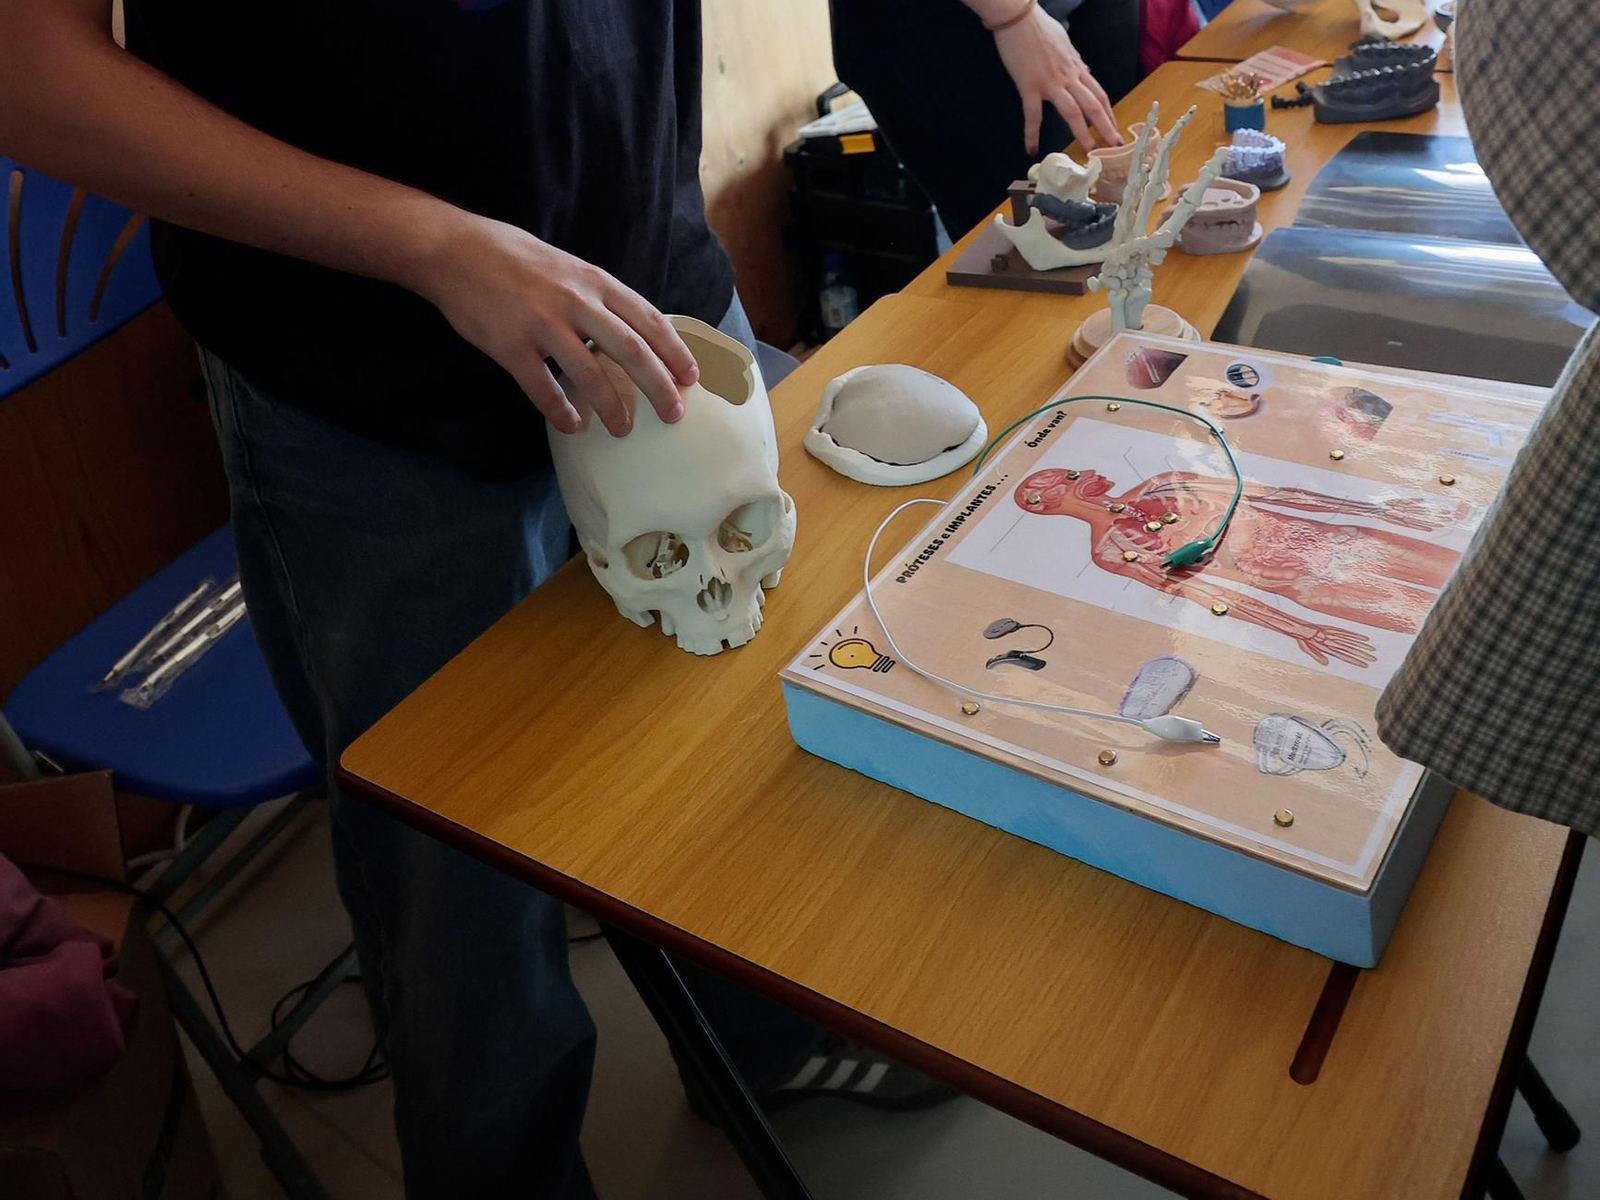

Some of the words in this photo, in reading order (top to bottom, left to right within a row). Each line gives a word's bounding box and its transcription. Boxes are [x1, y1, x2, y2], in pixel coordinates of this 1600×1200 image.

[1023, 428, 1052, 448] Ónde
[1047, 410, 1068, 429] van?
[895, 538, 945, 584] PRÓTESES
